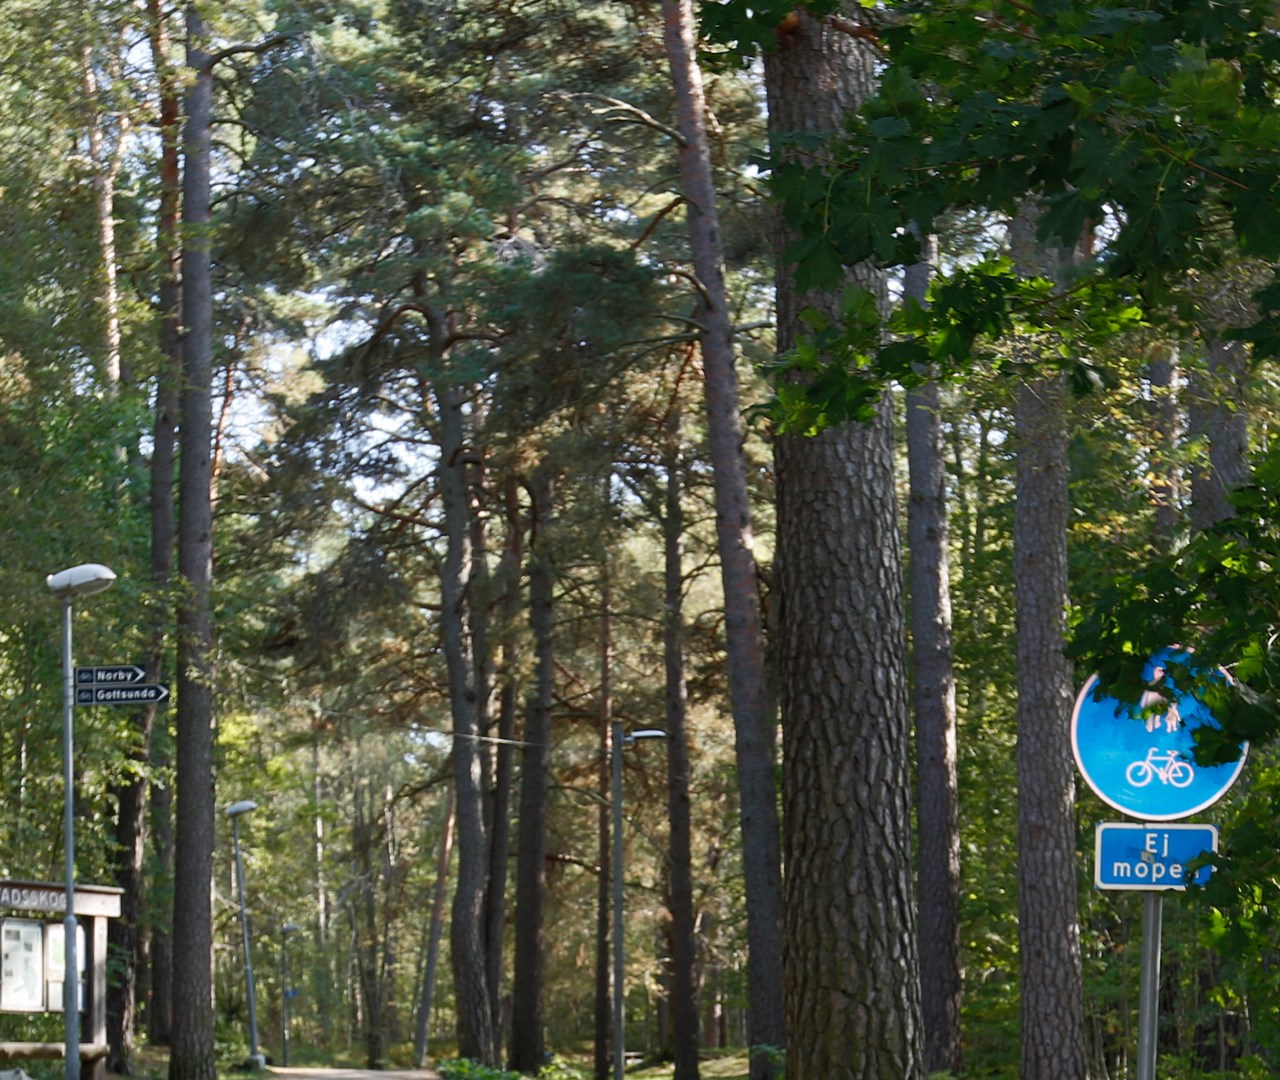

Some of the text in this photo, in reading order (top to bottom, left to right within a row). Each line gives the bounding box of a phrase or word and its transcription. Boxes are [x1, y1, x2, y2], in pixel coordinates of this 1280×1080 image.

[97, 670, 133, 683] Norby
[97, 688, 156, 700] Gottsunda
[1145, 833, 1170, 858] Ej
[1113, 862, 1200, 883] mope
